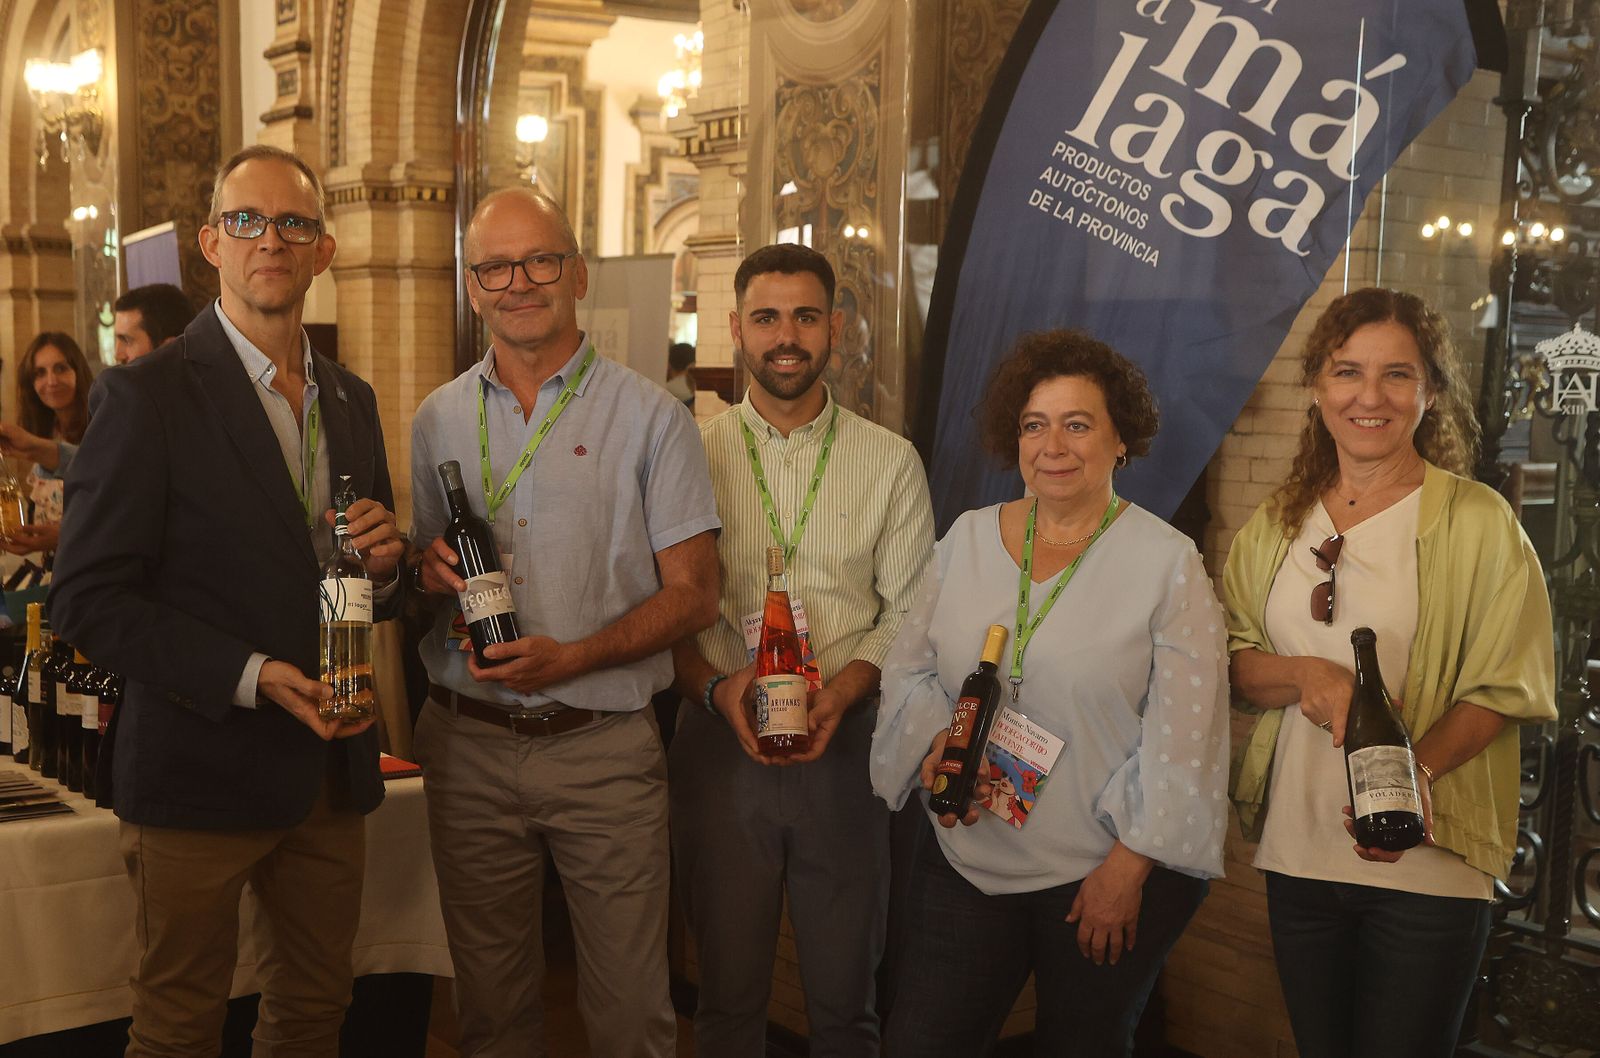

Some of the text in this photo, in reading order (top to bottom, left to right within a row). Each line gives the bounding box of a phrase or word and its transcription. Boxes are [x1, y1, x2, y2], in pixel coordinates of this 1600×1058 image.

[1064, 31, 1311, 257] laga
[1052, 141, 1152, 201] PRODUCTOS
[1039, 166, 1149, 230] AUTÓCTONOS
[1028, 189, 1160, 268] DE LA PROVINCIA
[1561, 404, 1585, 416] XIII
[771, 698, 801, 707] ARIYANAS
[948, 724, 963, 737] 12
[1001, 711, 1049, 744] Montse Navarro
